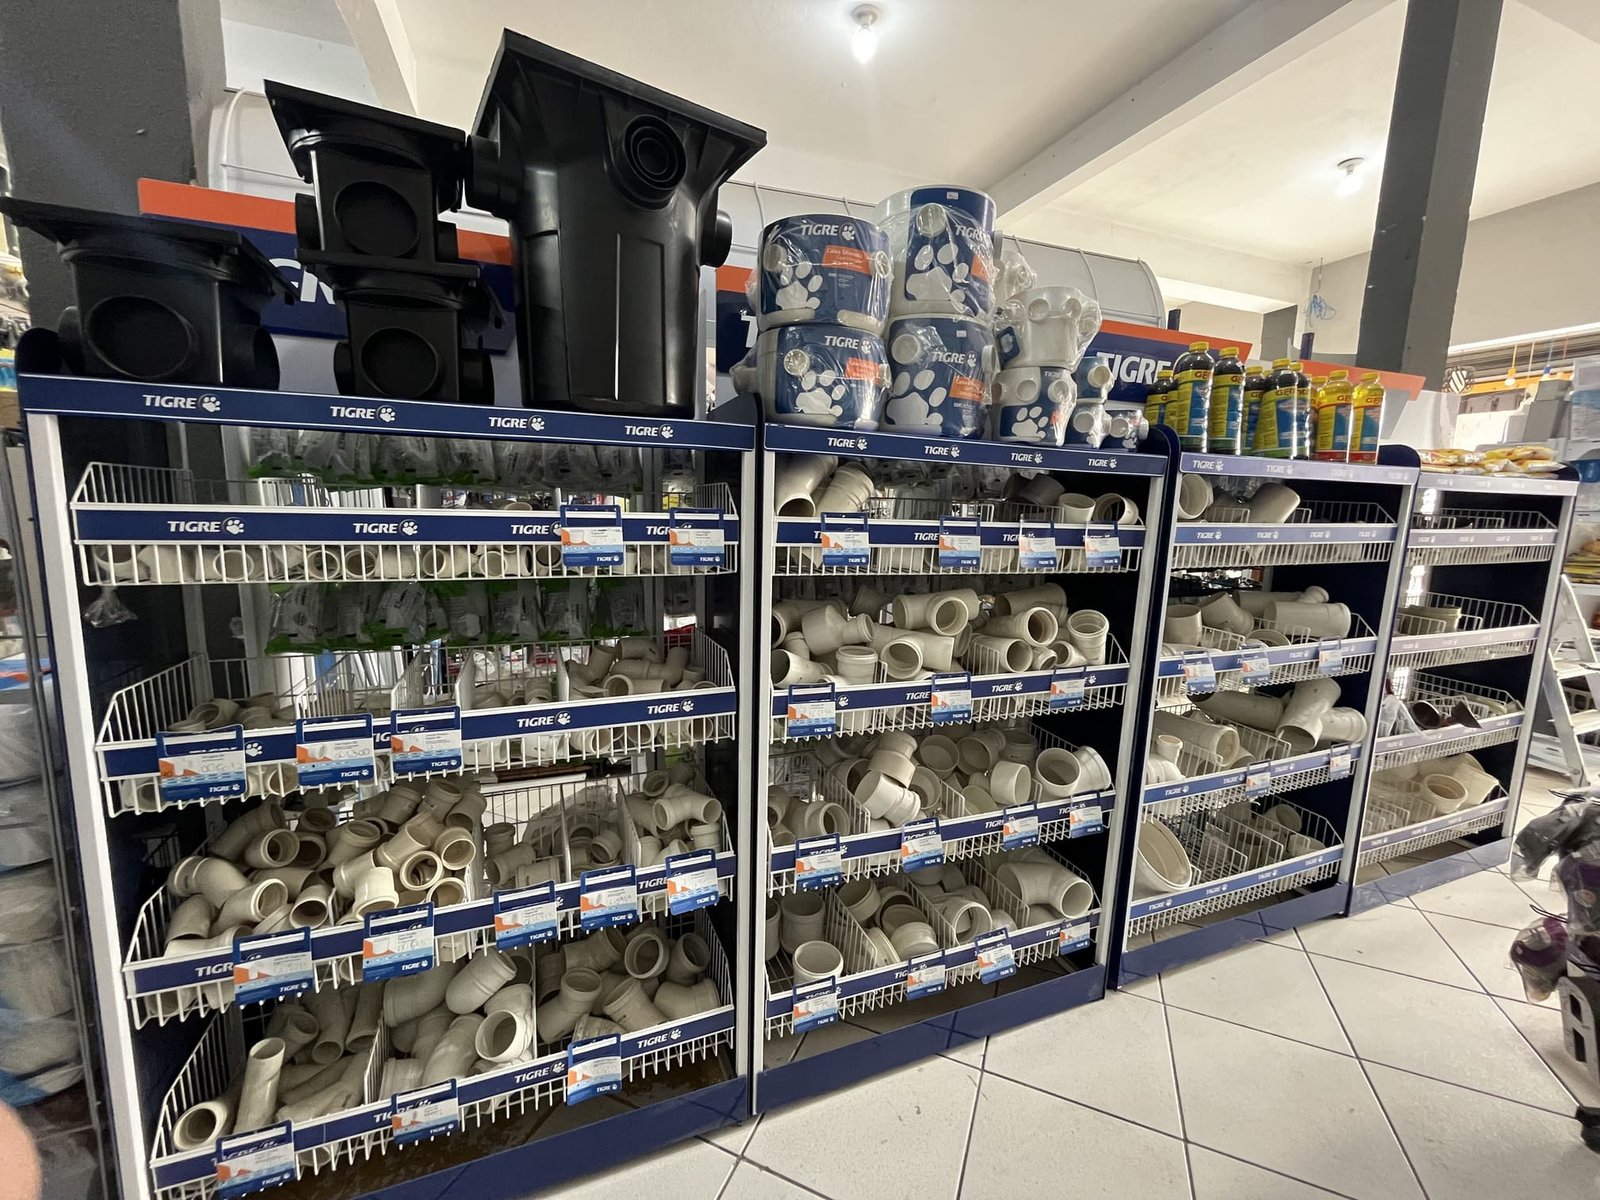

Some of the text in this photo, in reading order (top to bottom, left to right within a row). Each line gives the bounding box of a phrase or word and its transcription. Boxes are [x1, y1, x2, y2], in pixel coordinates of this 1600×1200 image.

[801, 224, 839, 236] TIGRE
[824, 335, 859, 349] TIGRE
[932, 352, 965, 364] TIGRE
[143, 394, 197, 410] TIGRE
[330, 405, 376, 420] TIGRE
[489, 416, 528, 429] TIGRE
[624, 425, 659, 437] TIGRE
[827, 437, 855, 449] TIGRE
[924, 446, 949, 456] TIGRE
[1011, 452, 1033, 462] TIGRE
[1088, 458, 1109, 468] TIGRE
[1192, 460, 1214, 470] TIGRE
[168, 521, 221, 533] TIGRE
[353, 523, 398, 534] TIGRE
[511, 524, 549, 535] TIGRE
[914, 532, 939, 541] TIGRE
[992, 684, 1013, 692] TIGRE
[906, 691, 931, 700] TIGRE
[647, 703, 680, 715] TIGRE
[517, 715, 555, 728] TIGRE
[340, 770, 361, 778] TIGRE
[209, 785, 230, 793] TIGRE
[195, 962, 234, 977] TIGR
[401, 962, 420, 971] TIGRE
[637, 1033, 668, 1049] TIGRE
[514, 1067, 549, 1084] TIGRE
